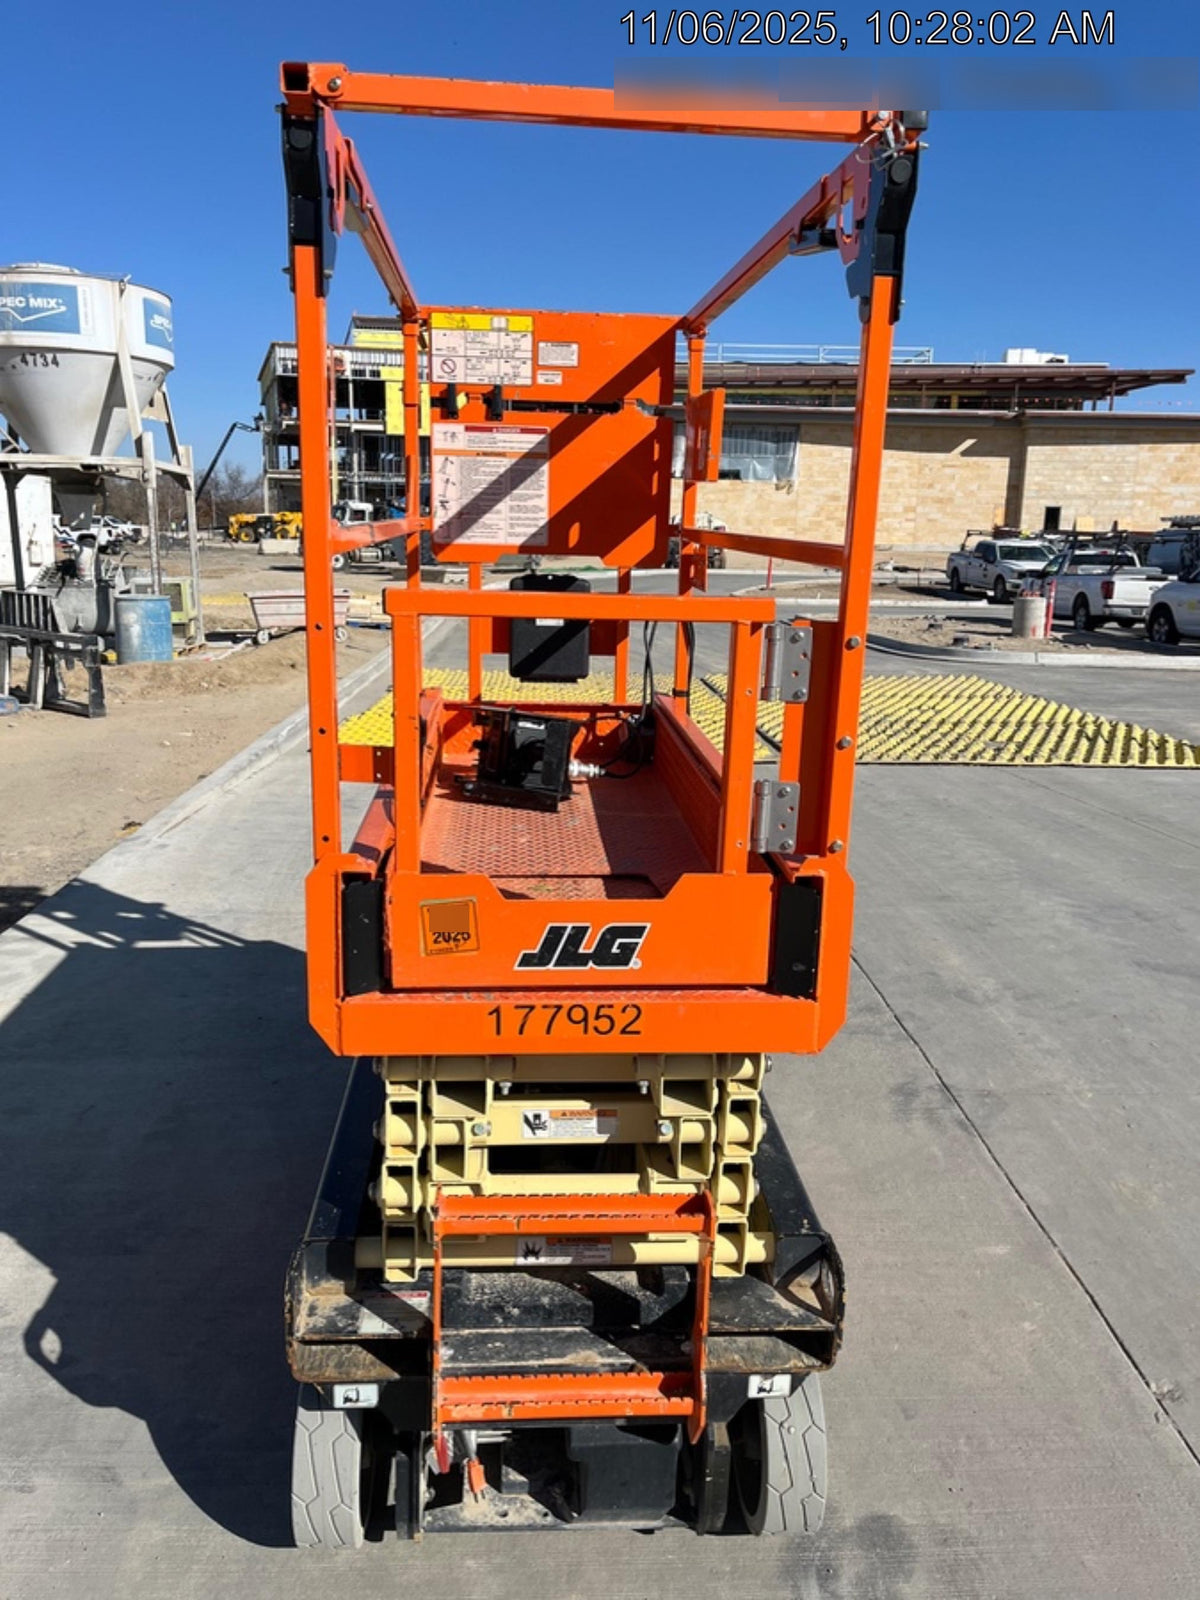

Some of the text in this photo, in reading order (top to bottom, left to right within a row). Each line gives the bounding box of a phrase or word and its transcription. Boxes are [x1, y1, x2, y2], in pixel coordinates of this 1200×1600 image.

[0, 296, 26, 308] PEC
[20, 352, 60, 368] 4734
[513, 922, 651, 970] JLG
[487, 1003, 643, 1037] 177952
